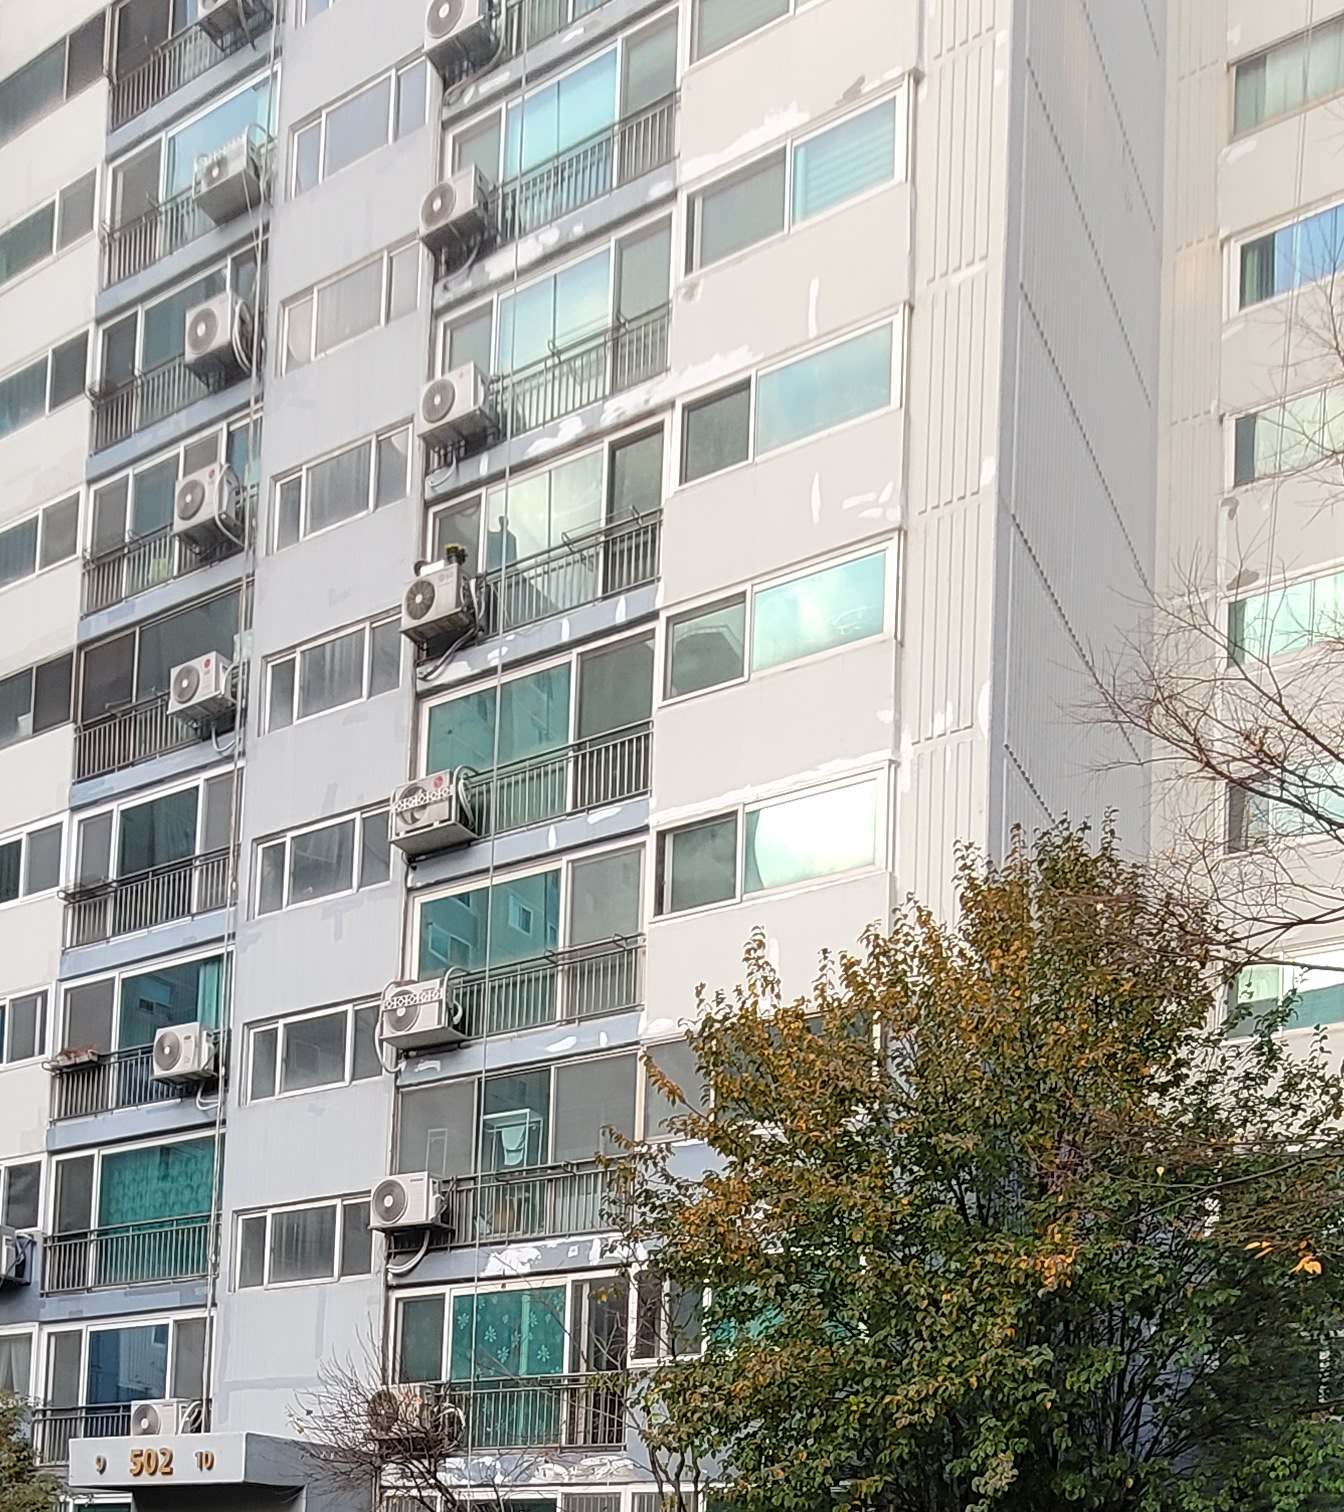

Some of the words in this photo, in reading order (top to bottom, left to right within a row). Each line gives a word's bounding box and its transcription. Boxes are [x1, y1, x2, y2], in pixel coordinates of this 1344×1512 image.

[95, 1455, 106, 1474] 9
[129, 1448, 173, 1476] 502
[194, 1451, 214, 1472] 10
